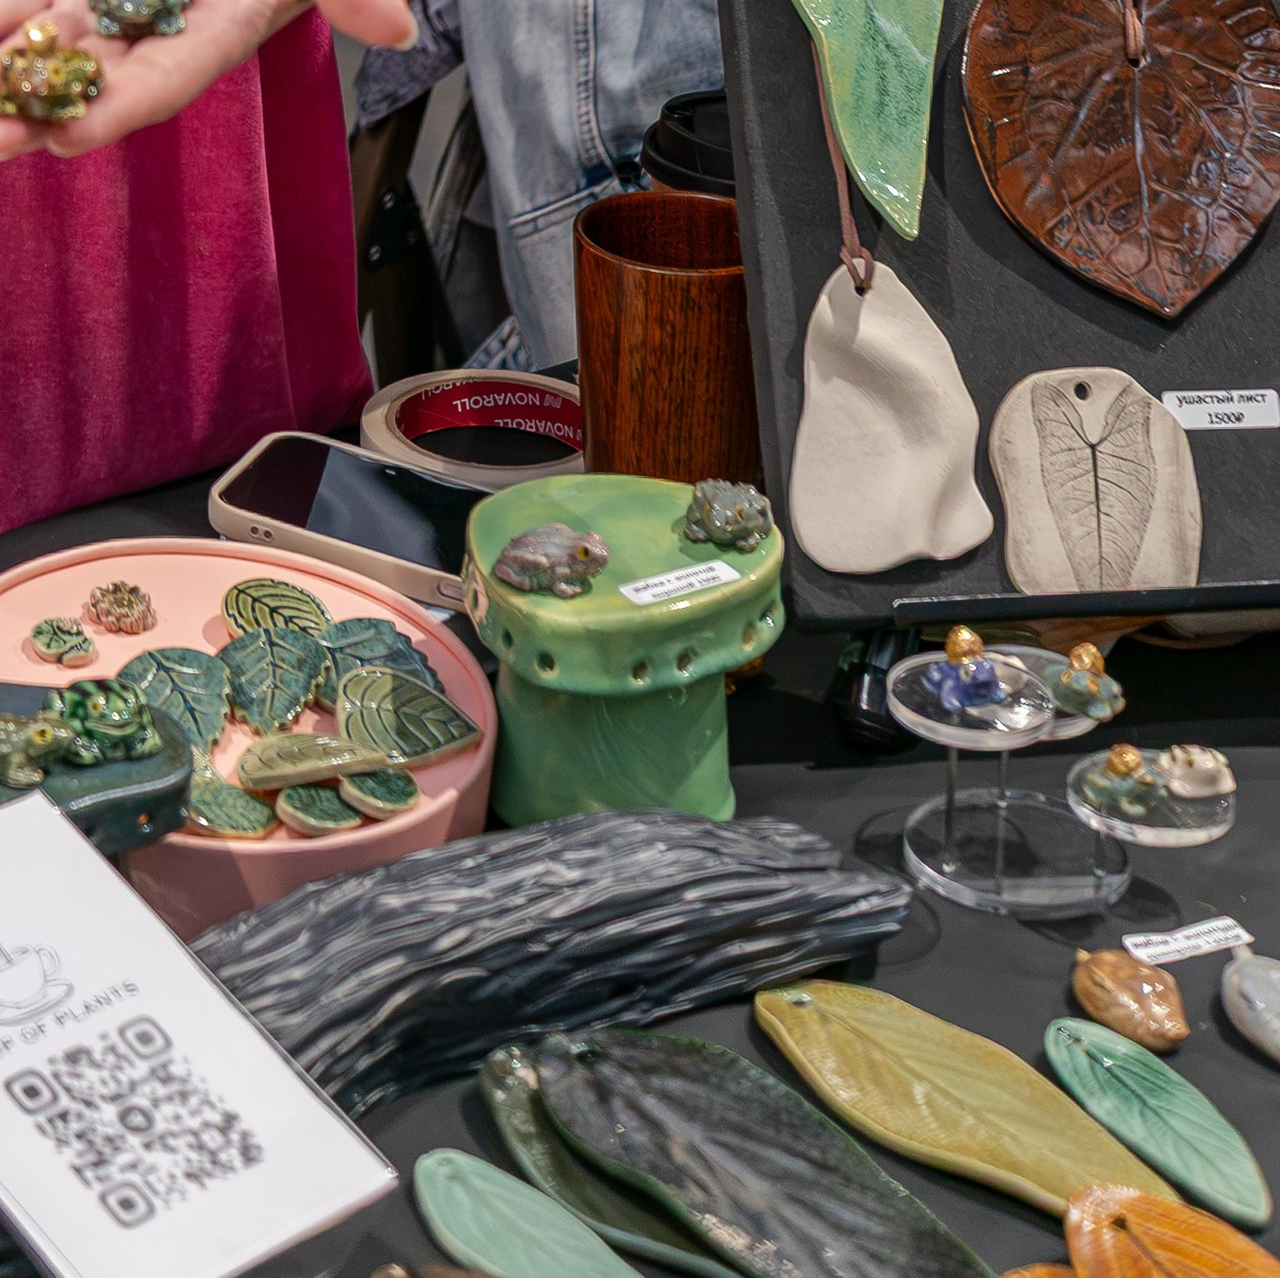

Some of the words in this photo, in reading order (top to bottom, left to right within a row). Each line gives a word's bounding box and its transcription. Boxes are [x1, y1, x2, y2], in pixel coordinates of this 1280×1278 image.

[452, 393, 540, 412] NOVAROLL
[1176, 391, 1235, 408] ушастый
[1237, 394, 1267, 404] лист
[20, 1022, 47, 1044] OF
[54, 981, 140, 1025] PLANTS
